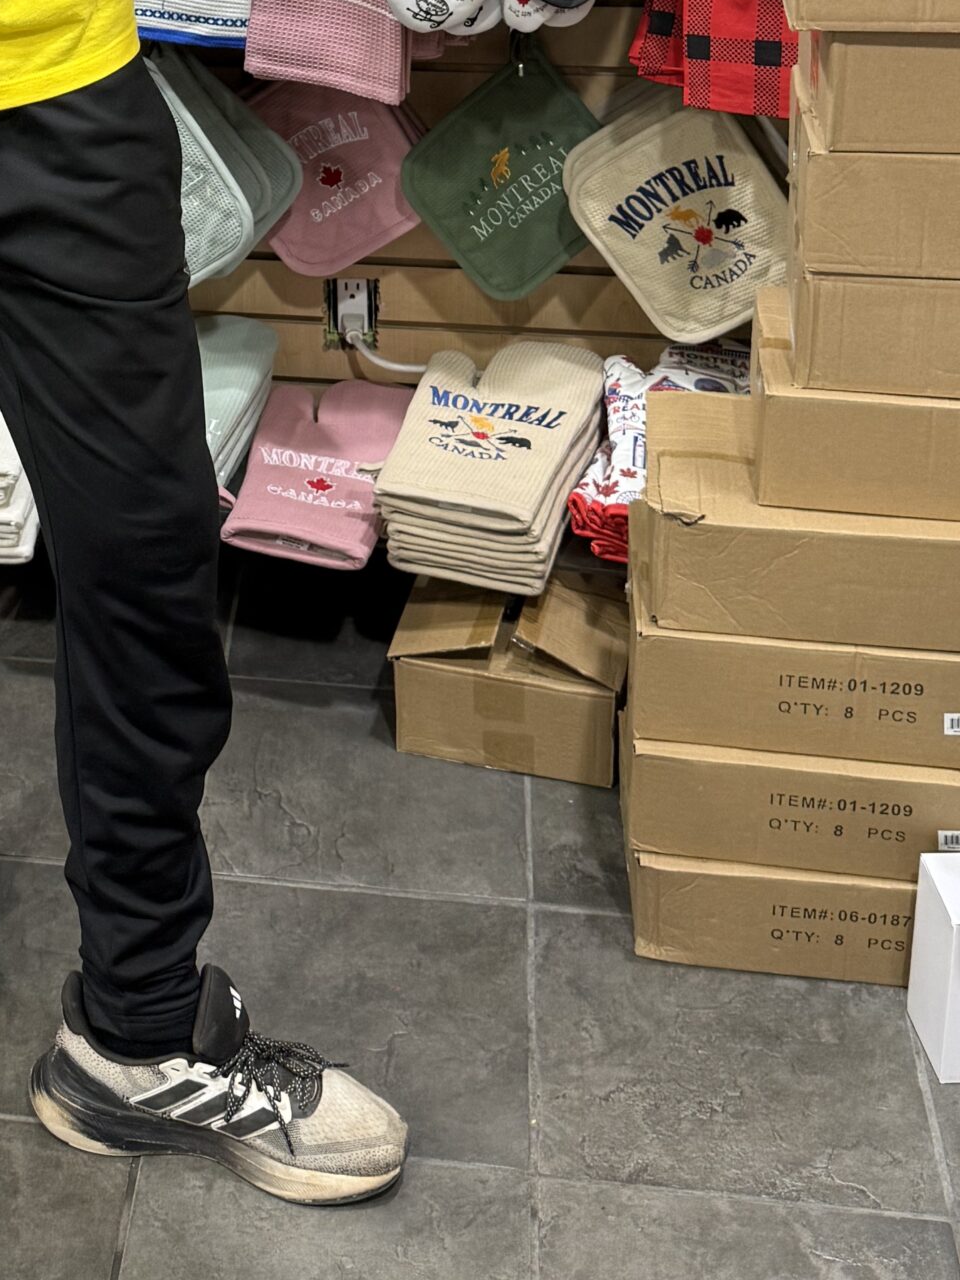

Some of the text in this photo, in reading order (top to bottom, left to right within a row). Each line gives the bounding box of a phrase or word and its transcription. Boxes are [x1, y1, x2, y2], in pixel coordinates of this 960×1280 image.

[311, 171, 383, 222] CANADA
[507, 181, 563, 229] CANADA
[608, 154, 736, 240] MONTREAL
[689, 253, 757, 290] CANADA
[429, 385, 567, 430] MONTREAL
[428, 435, 508, 461] CANADA
[266, 483, 363, 510] CANADA
[843, 706, 855, 719] 8
[877, 708, 918, 724] PCS
[833, 824, 844, 838] 8
[867, 827, 907, 842] PCS
[833, 933, 845, 947] 8
[867, 936, 906, 952] PCS
